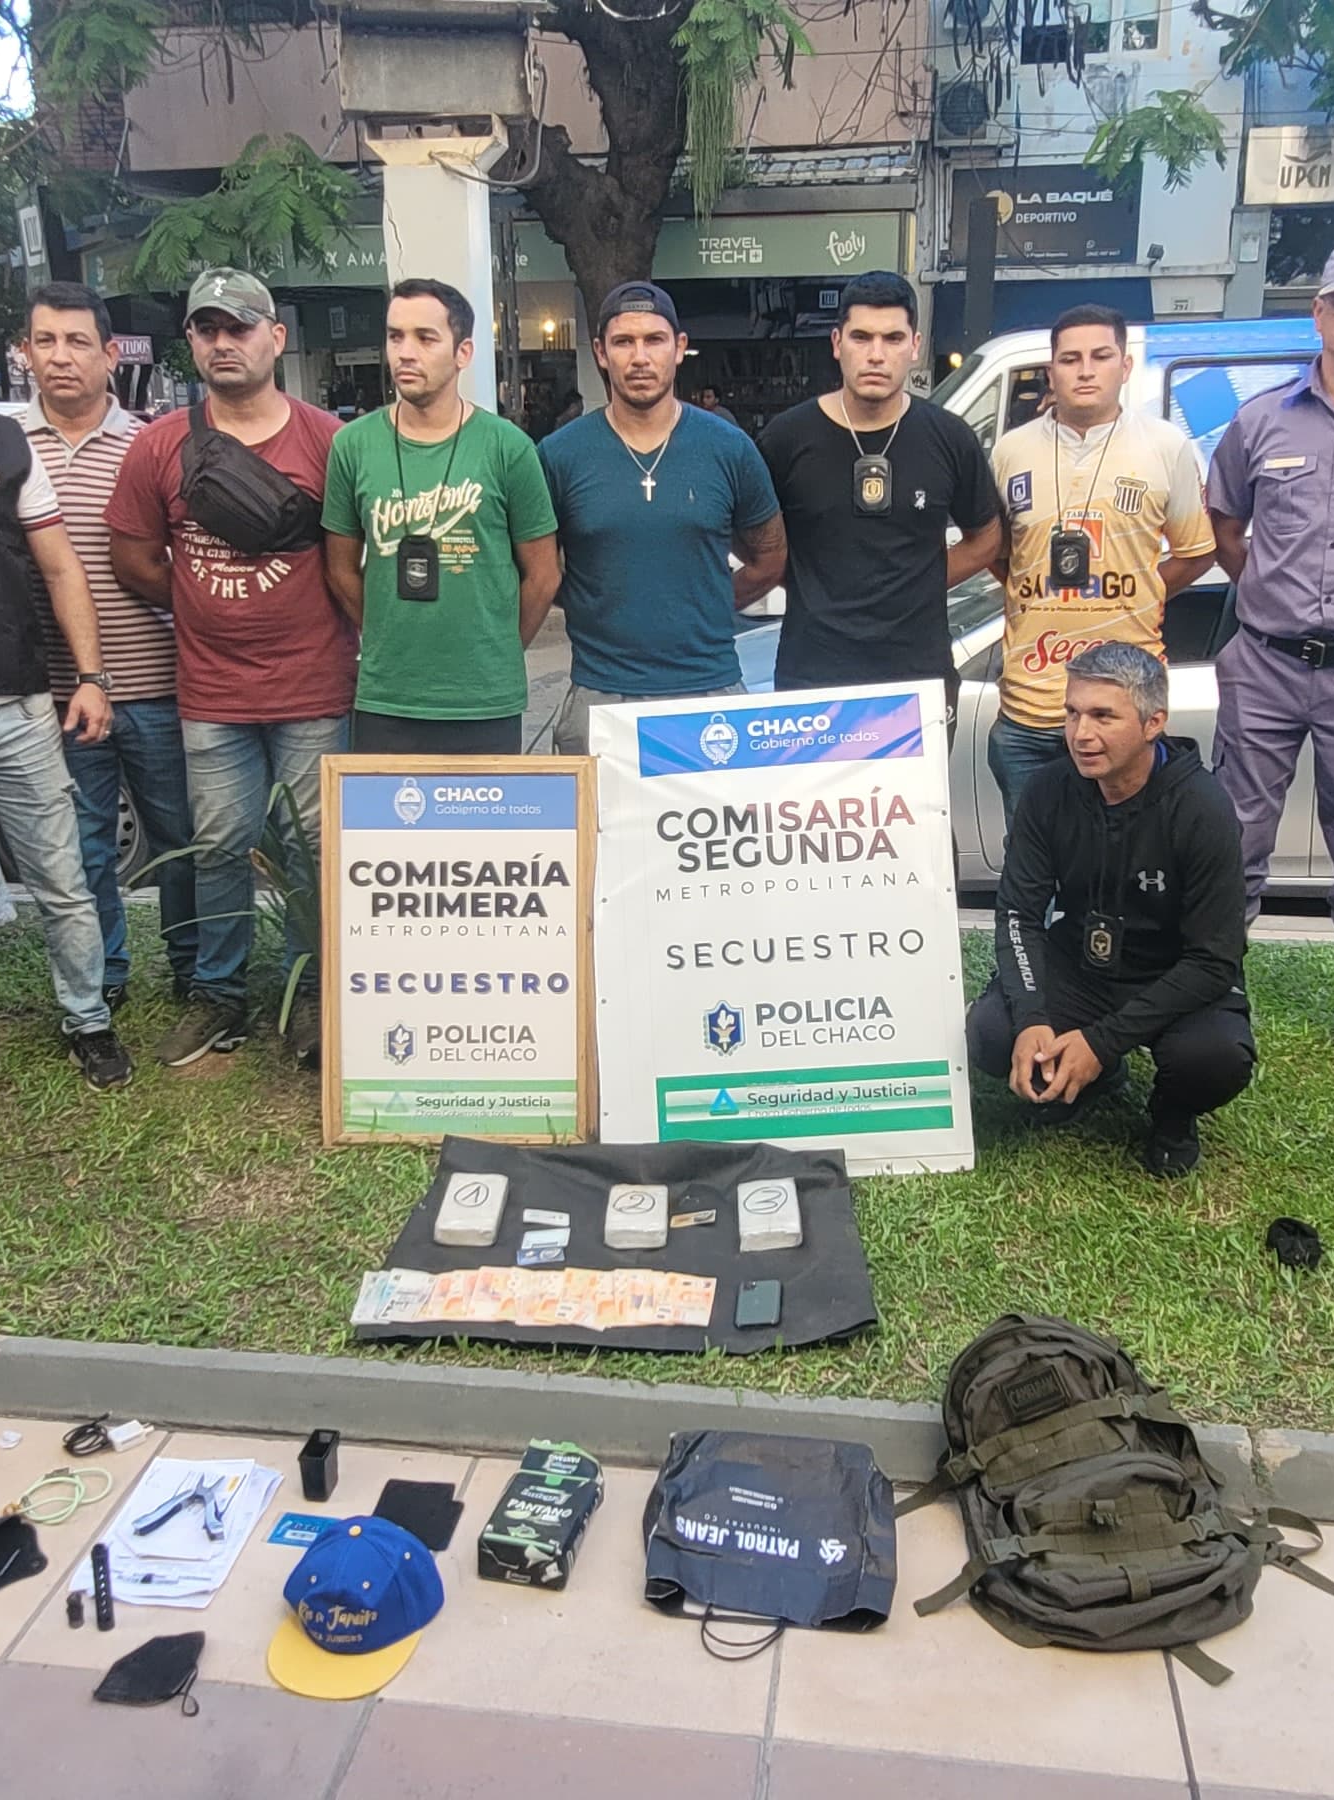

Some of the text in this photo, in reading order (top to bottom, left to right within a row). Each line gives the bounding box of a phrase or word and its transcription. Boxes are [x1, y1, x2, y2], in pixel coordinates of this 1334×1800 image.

[1016, 188, 1113, 204] LA BAQUÉ
[1015, 212, 1077, 224] DEPORTIVO
[699, 237, 762, 249] TRAVEL
[699, 251, 746, 264] TECH
[210, 575, 249, 599] THE
[256, 558, 292, 593] AIR
[746, 714, 831, 737] CHACO
[749, 730, 880, 751] Gobierno de todos
[433, 787, 503, 802] CHACO
[434, 804, 542, 815] Gobierno de todos
[657, 785, 916, 842] COMISARÍA
[677, 829, 899, 873] SEGUNDA
[348, 852, 571, 887] COMISARÍA
[656, 871, 920, 904] METROPOLITANA
[371, 892, 548, 918] PRIMERA
[349, 925, 567, 937] METROPOLITANA
[667, 928, 925, 970] SECUESTRO
[349, 972, 570, 994] SECUESTRO
[755, 996, 893, 1026] POLICIA
[426, 1025, 537, 1044] POLICIA
[761, 1024, 896, 1048] DEL CHACO
[429, 1047, 537, 1062] DEL CHACO
[416, 1095, 551, 1109] Seguridad y Justicia
[747, 1082, 917, 1108] Seguridad y Justicia
[507, 1498, 573, 1518] PANTANO
[675, 1515, 800, 1559] PATROL JEANS
